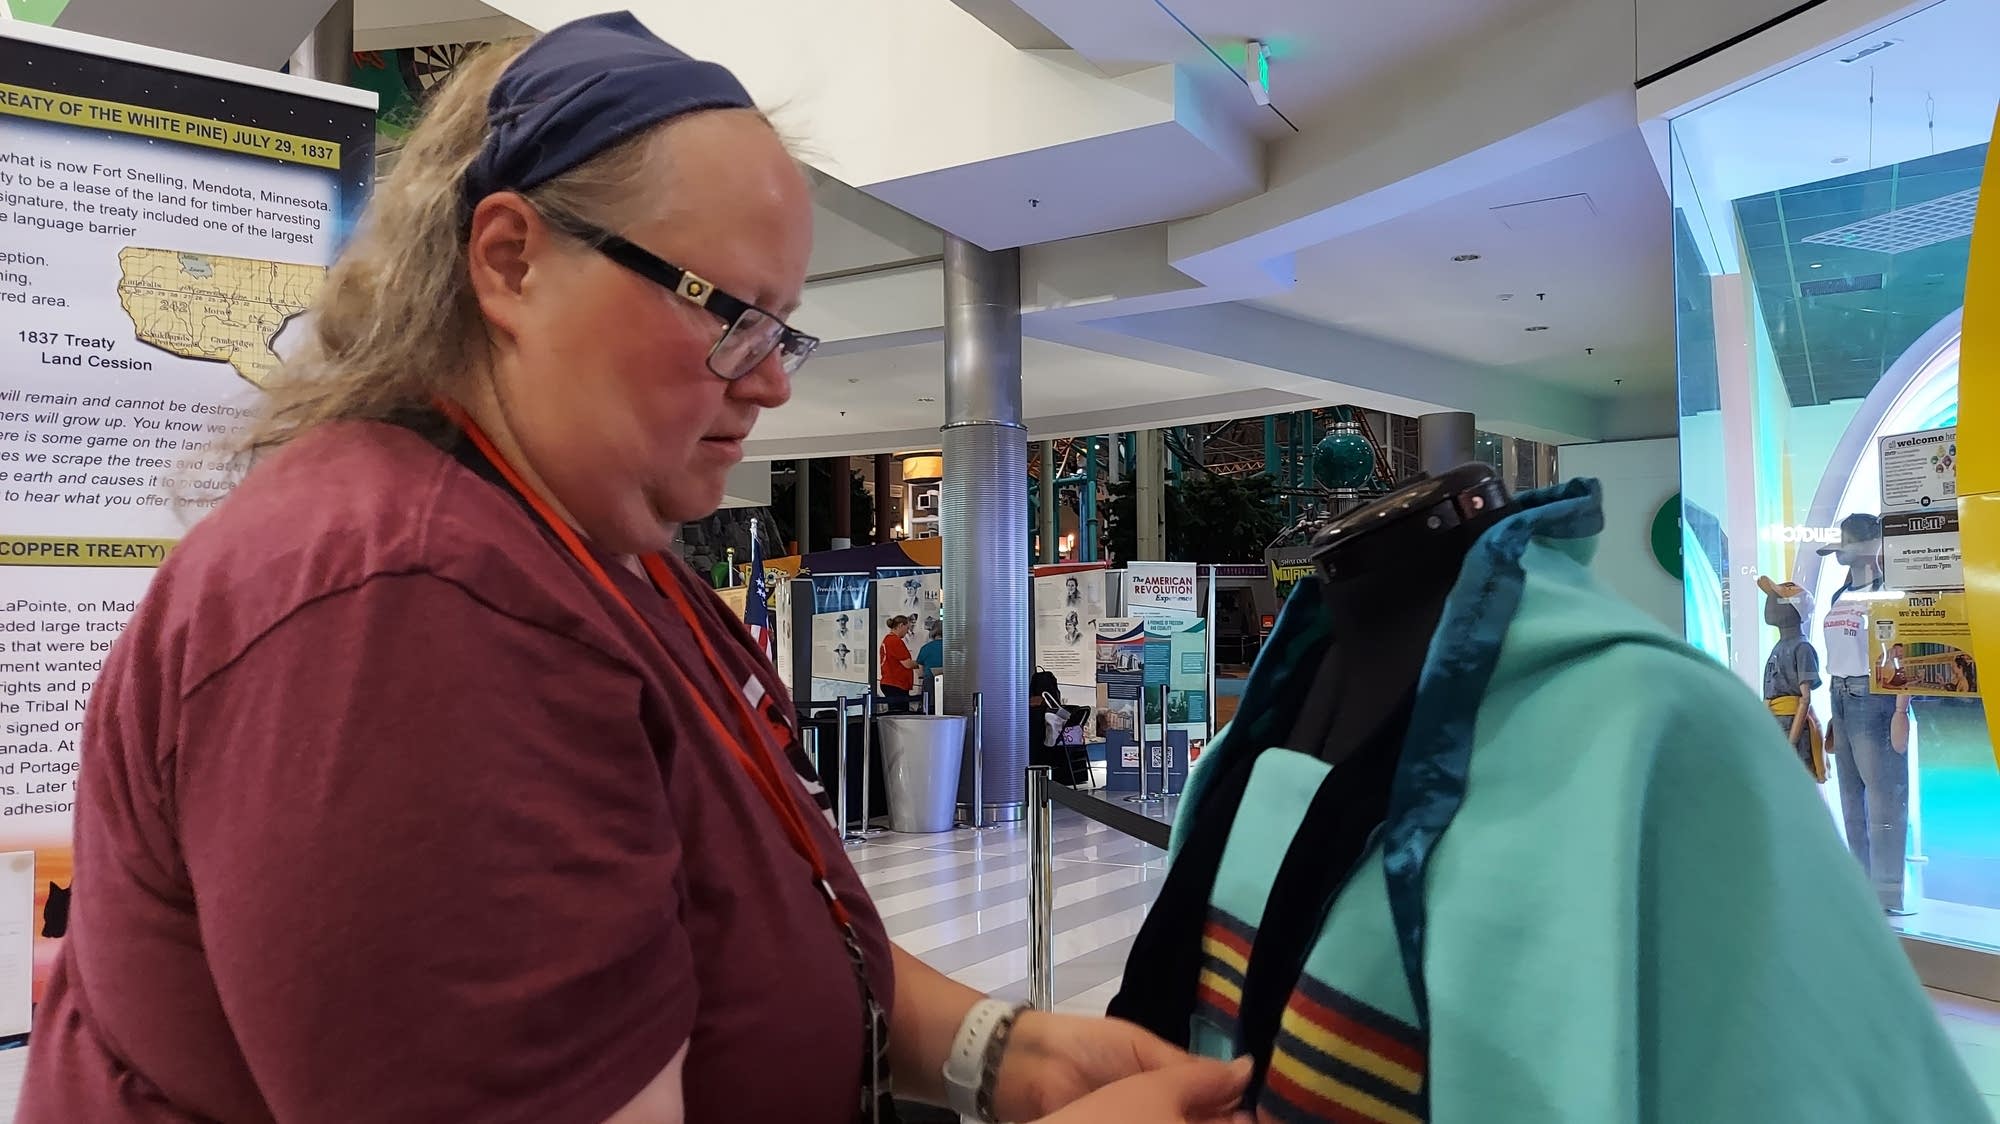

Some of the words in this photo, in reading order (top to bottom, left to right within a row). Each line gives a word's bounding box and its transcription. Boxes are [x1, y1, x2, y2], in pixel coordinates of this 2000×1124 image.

[59, 101, 83, 116] OF
[89, 105, 122, 123] THE
[127, 111, 180, 132] WHITE
[186, 122, 228, 143] PINE)
[232, 131, 270, 148] JULY
[275, 139, 295, 155] 29,
[301, 143, 333, 160] 1837
[0, 152, 35, 167] what
[40, 156, 52, 169] is
[57, 162, 88, 174] now
[93, 164, 122, 178] Fort
[126, 168, 187, 190] Snelling,
[193, 178, 255, 200] Mendota,
[260, 190, 331, 212] Minnesota.
[18, 174, 32, 185] to
[37, 176, 55, 189] be
[59, 182, 68, 191] a
[73, 181, 111, 196] lease
[115, 187, 129, 198] of
[132, 189, 154, 202] the
[158, 192, 186, 206] land
[191, 197, 208, 209] for
[212, 201, 252, 216] timber
[256, 208, 321, 230] harvesting
[13, 212, 84, 232] language
[89, 221, 137, 237] barrier
[73, 201, 95, 214] the
[99, 204, 138, 221] treaty
[143, 208, 199, 226] included
[203, 219, 227, 231] one
[231, 223, 245, 233] of
[247, 225, 267, 237] the
[271, 228, 314, 244] largest
[0, 291, 26, 303] red
[31, 294, 70, 308] area.
[19, 330, 58, 344] 1837
[64, 333, 115, 351] Treaty
[41, 351, 82, 366] Land
[88, 355, 152, 371] Cession
[24, 393, 78, 406] remain
[82, 396, 111, 407] and
[115, 398, 165, 410] cannot
[168, 400, 187, 412] be
[34, 412, 59, 424] will
[62, 415, 100, 428] grow
[104, 417, 126, 430] up.
[133, 416, 160, 429] You
[165, 419, 202, 432] know
[206, 424, 226, 434] we
[24, 430, 36, 442] is
[41, 433, 82, 445] some
[86, 435, 128, 448] game
[132, 438, 150, 448] on
[155, 437, 177, 449] the
[1897, 434, 1944, 447] welcome
[0, 451, 20, 462] es
[25, 452, 46, 463] we
[51, 454, 103, 467] scrape
[107, 454, 131, 466] the
[135, 455, 172, 469] trees
[176, 459, 203, 470] and
[13, 471, 53, 483] earth
[58, 473, 87, 484] and
[91, 475, 144, 487] causes
[148, 475, 157, 487] it
[161, 477, 175, 488] to
[4, 490, 19, 501] to
[24, 490, 60, 503] hear
[64, 492, 100, 504] what
[104, 495, 131, 507] you
[136, 494, 170, 506] offer
[0, 541, 80, 557] COPPER
[86, 543, 165, 561] TREATY)
[1144, 576, 1193, 585] AMERICAN
[1134, 585, 1193, 594] REVOLUTION
[77, 602, 96, 612] on
[102, 600, 139, 612] Mad
[1155, 594, 1193, 603] Expence
[1899, 609, 1919, 618] we're
[1920, 608, 1946, 618] hiring
[41, 621, 80, 634] large
[11, 640, 41, 652] that
[46, 642, 85, 652] were
[90, 640, 114, 652] bel
[0, 661, 40, 673] ment
[45, 660, 102, 672] wanted
[47, 680, 76, 692] and
[25, 699, 69, 712] Tribal
[6, 720, 59, 736] signed
[57, 739, 74, 752] At
[20, 761, 80, 774] Portage
[26, 781, 67, 794] Later
